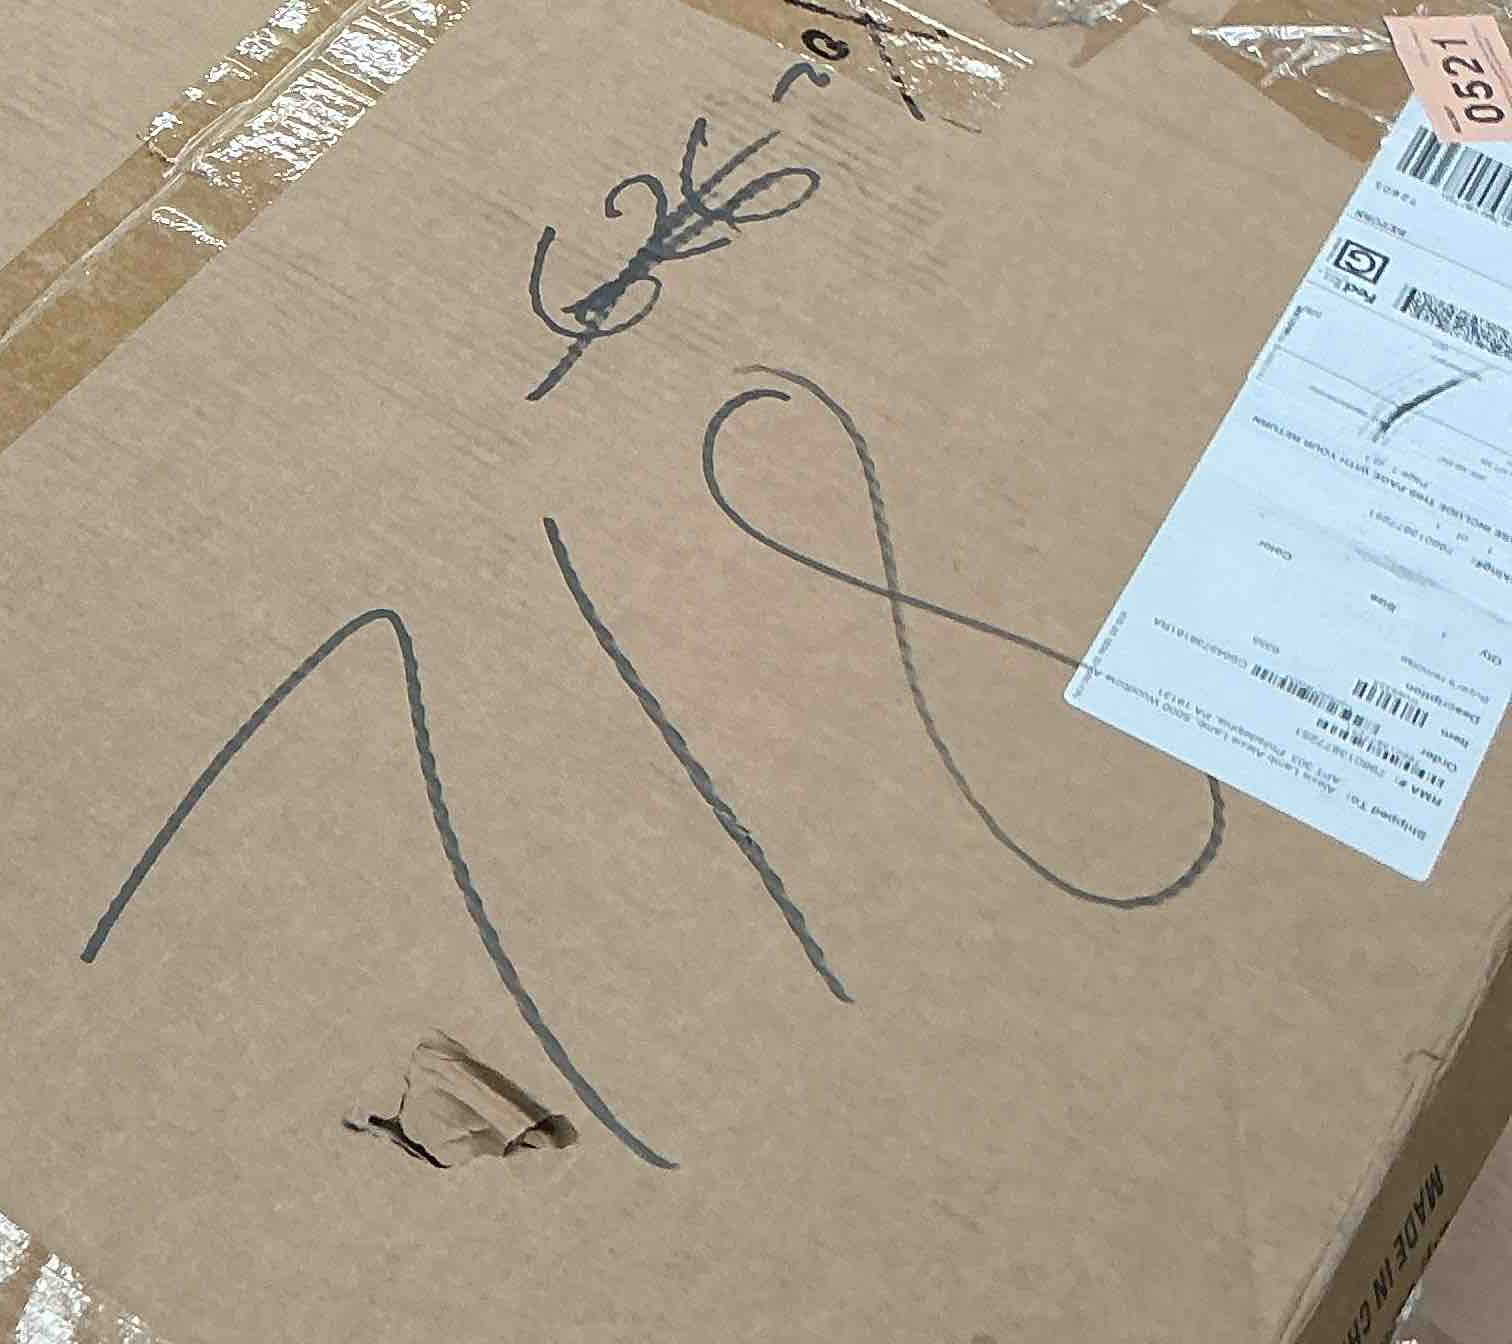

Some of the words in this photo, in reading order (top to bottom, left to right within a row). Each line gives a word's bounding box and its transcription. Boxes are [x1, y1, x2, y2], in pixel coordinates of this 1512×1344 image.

[1431, 38, 1505, 125] 0521
[1255, 536, 1294, 563] Color
[1403, 679, 1481, 725] Description
[1393, 1164, 1444, 1273] MADE
[1374, 1256, 1396, 1310] IN
